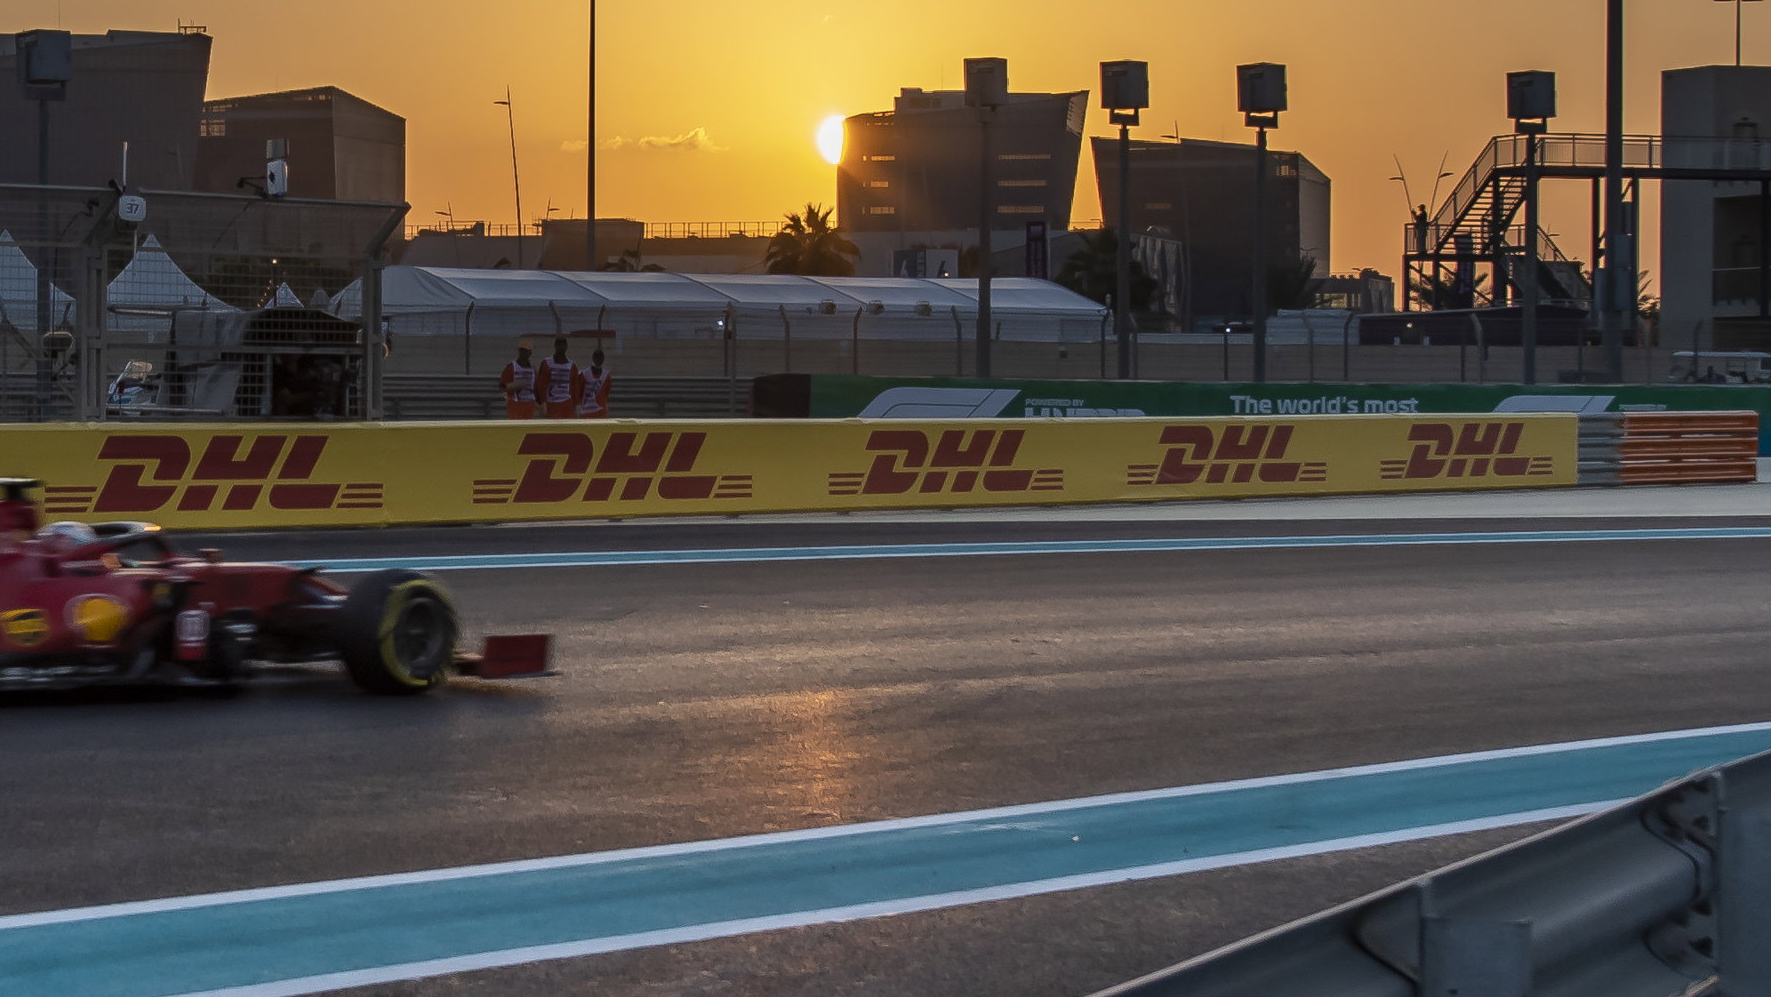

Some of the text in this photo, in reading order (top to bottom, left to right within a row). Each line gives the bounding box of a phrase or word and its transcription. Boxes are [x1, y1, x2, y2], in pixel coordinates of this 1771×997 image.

[126, 202, 140, 214] 37
[1025, 398, 1085, 407] POWERED BY
[1229, 395, 1419, 414] The world's most
[93, 435, 341, 513] DHL
[513, 431, 717, 504] DHL
[861, 429, 1034, 495] DHL
[1156, 425, 1302, 484] DHL
[1405, 422, 1531, 479] DHL
